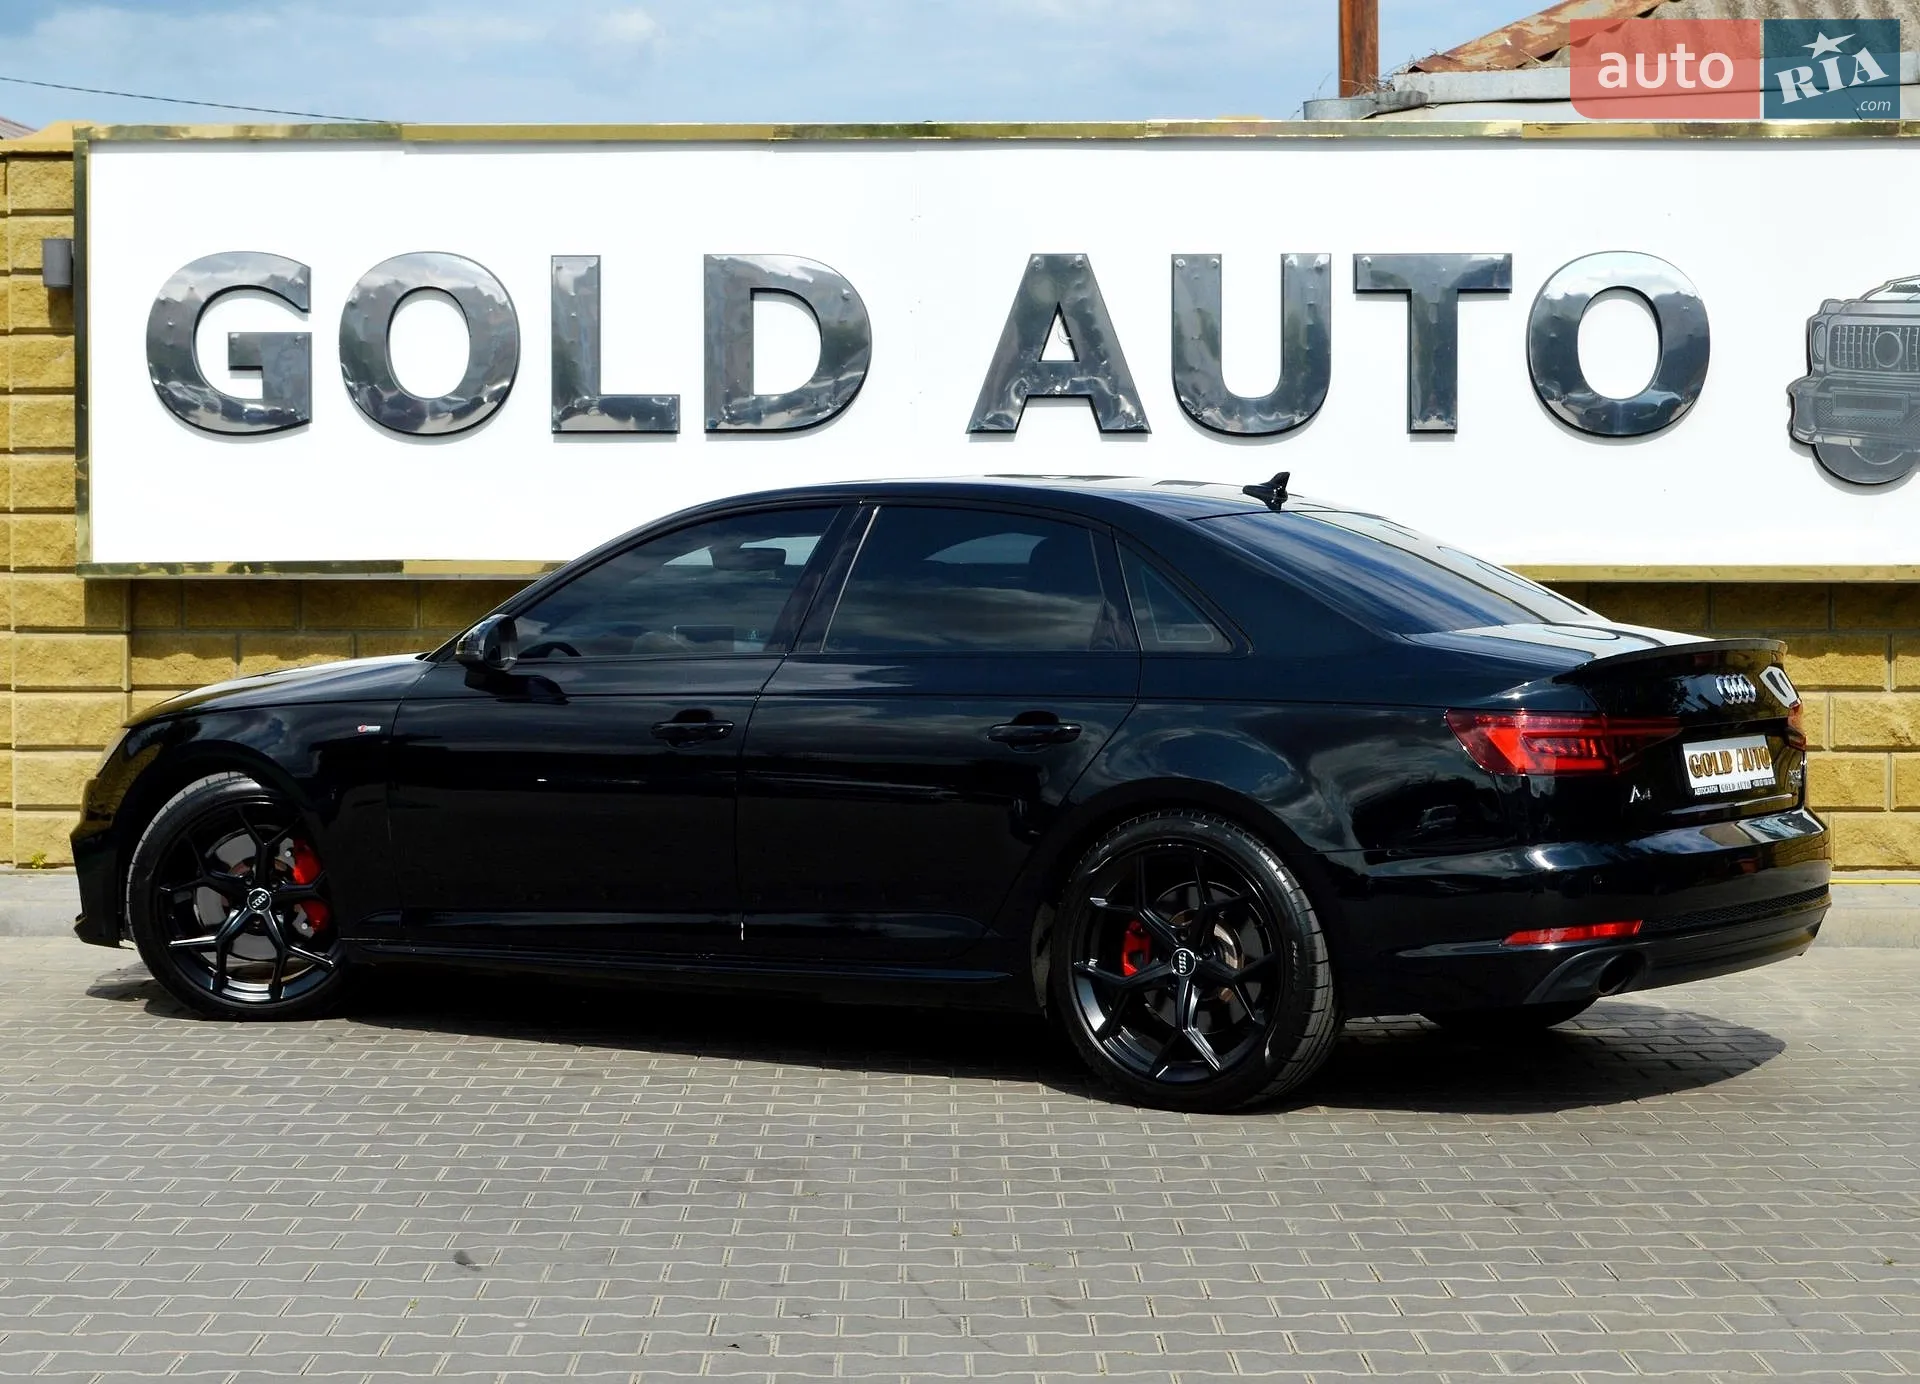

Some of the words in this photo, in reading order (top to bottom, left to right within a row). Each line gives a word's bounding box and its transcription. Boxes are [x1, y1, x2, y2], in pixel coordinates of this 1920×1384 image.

[146, 251, 872, 437] GOLD
[966, 250, 1711, 438] AUTO
[1688, 750, 1733, 779] GOLD
[1736, 745, 1772, 773] AUTO
